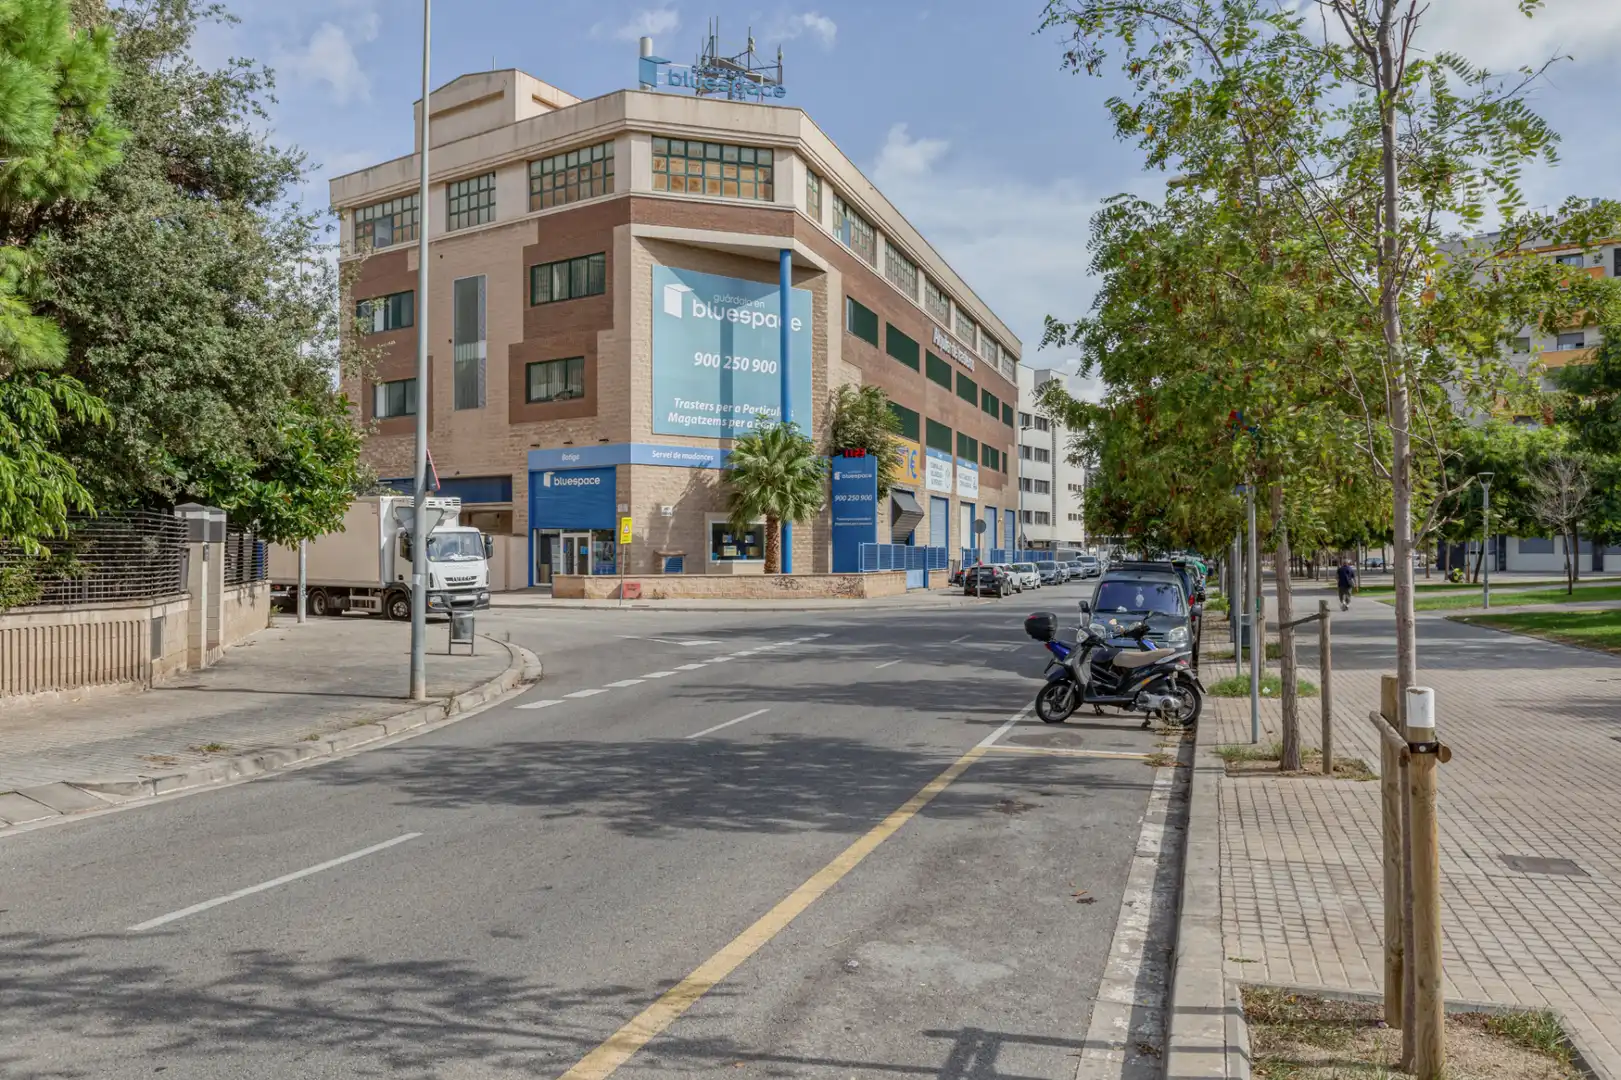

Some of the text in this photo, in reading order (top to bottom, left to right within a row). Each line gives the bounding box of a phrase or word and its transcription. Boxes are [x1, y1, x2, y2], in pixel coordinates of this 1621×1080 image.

[754, 300, 765, 309] en
[692, 299, 802, 331] bluespae
[694, 352, 777, 374] 900 250 900
[674, 397, 714, 412] Trasters
[716, 403, 733, 416] per
[734, 405, 741, 413] a
[668, 412, 727, 427] Magatzems
[728, 418, 745, 429] per
[746, 421, 753, 429] a
[652, 450, 672, 459] Servei
[554, 476, 601, 487] bluespace
